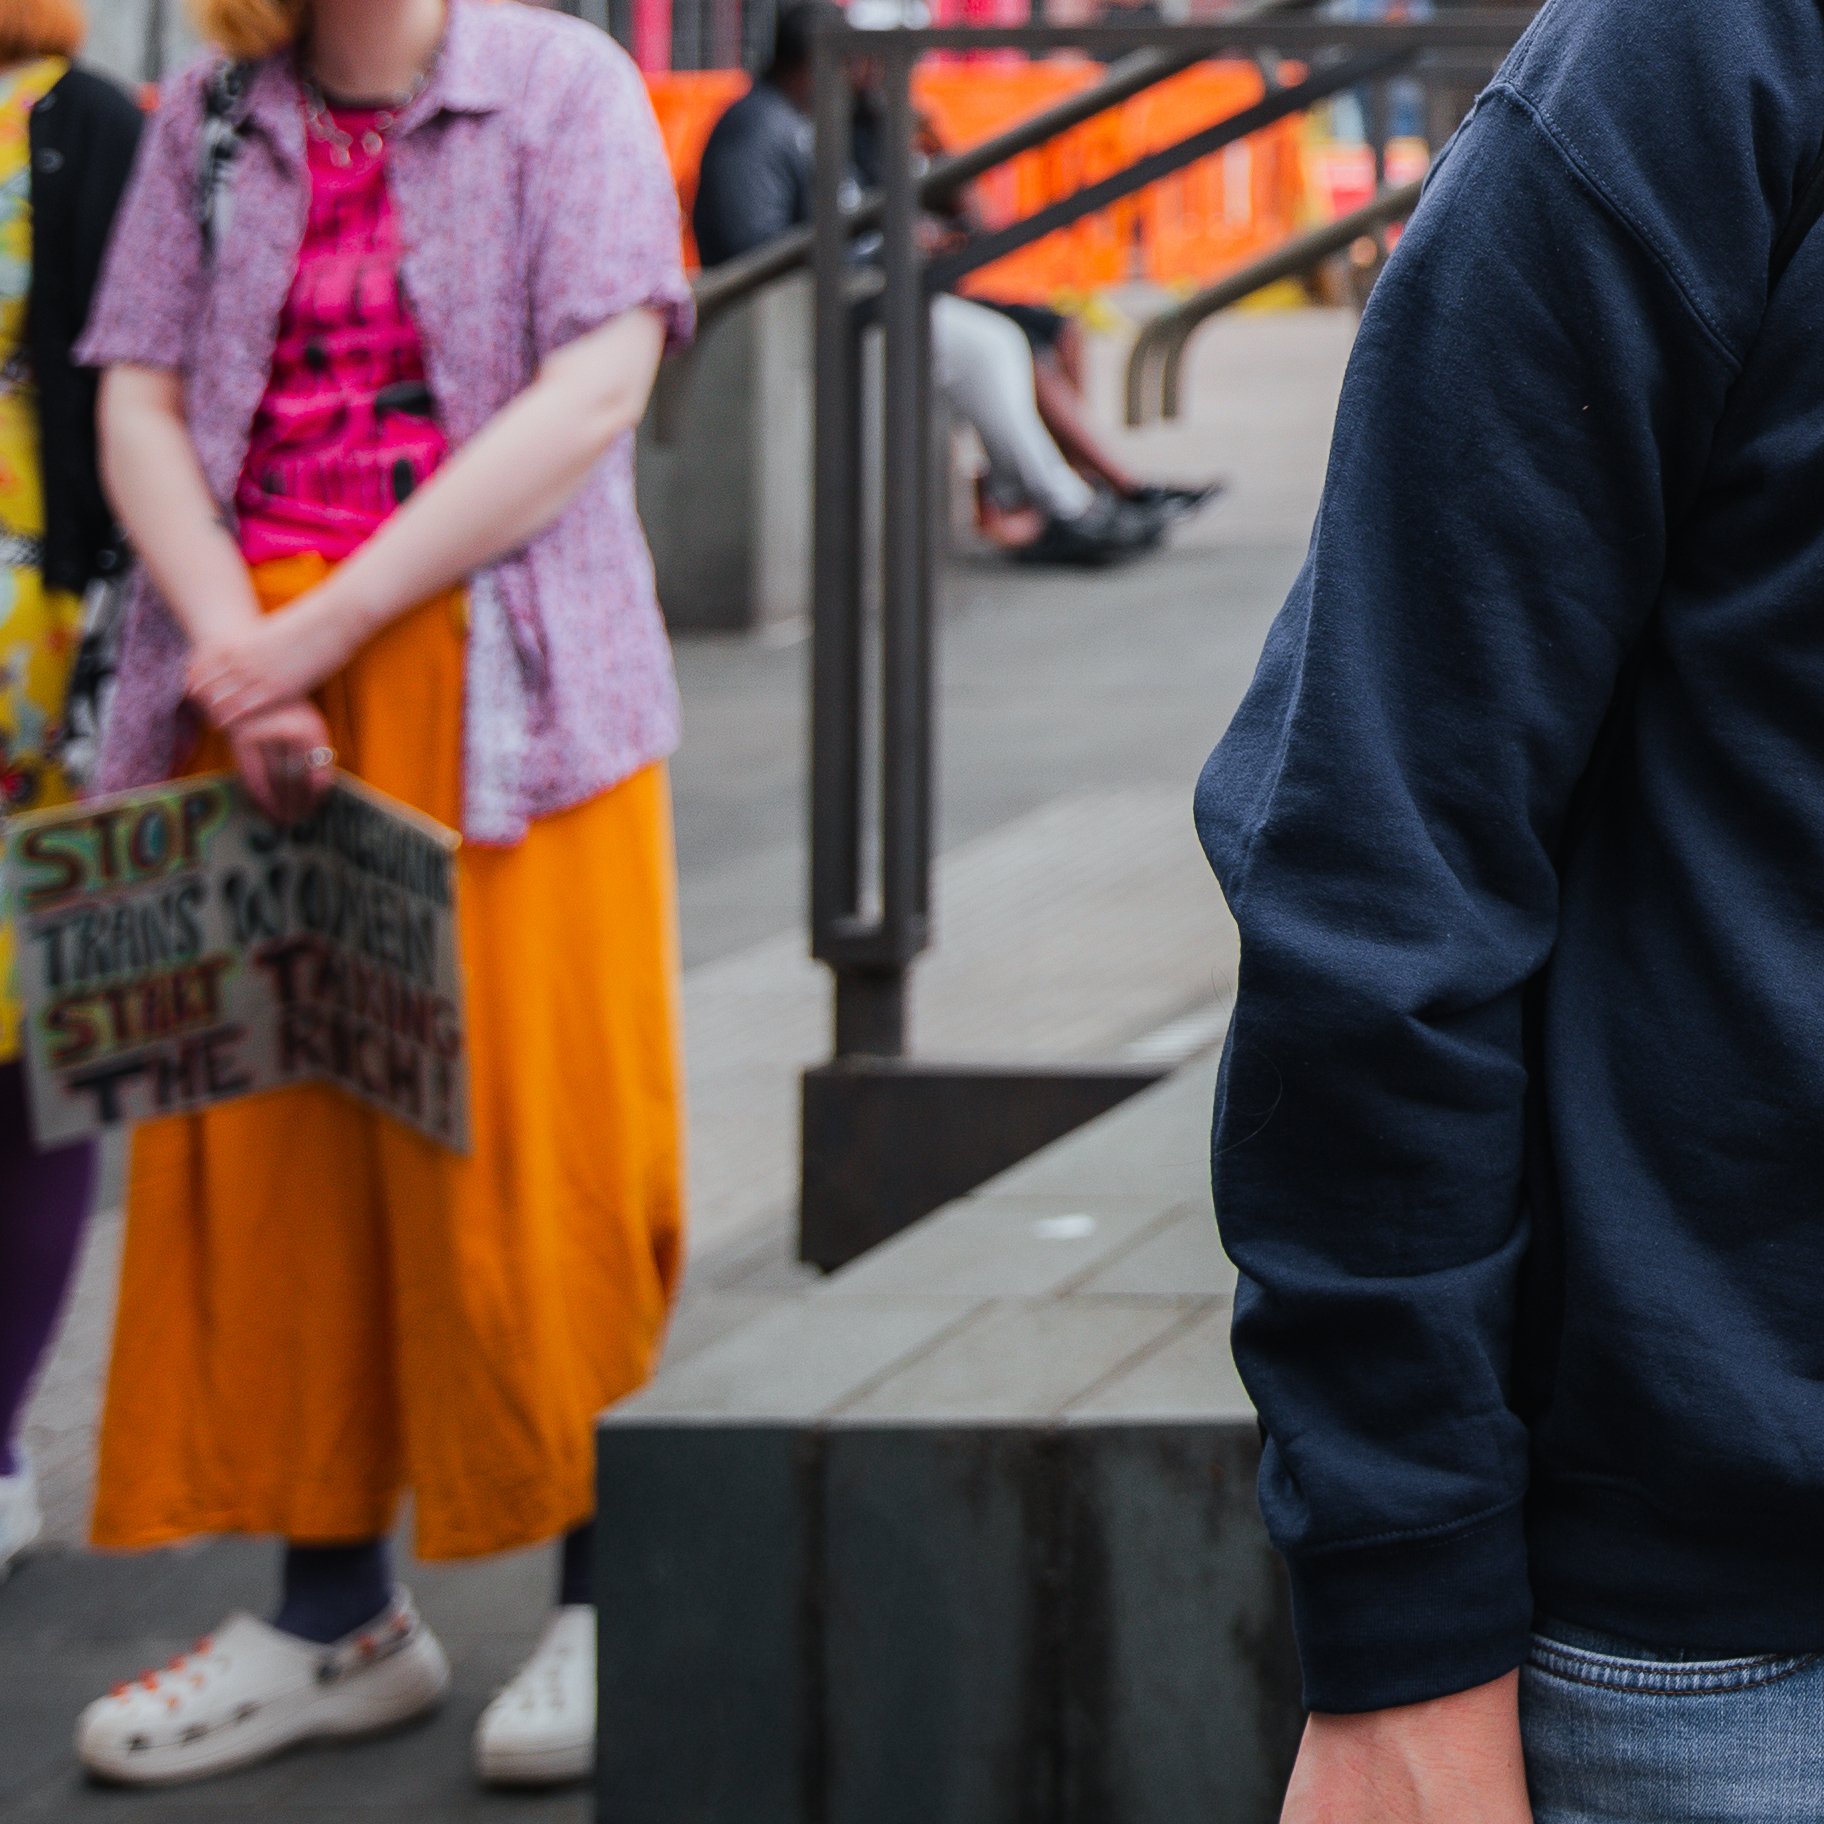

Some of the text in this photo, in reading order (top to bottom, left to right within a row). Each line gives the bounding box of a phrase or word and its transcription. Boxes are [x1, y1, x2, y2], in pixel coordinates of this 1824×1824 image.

[19, 786, 226, 909] STOP
[30, 882, 203, 988] TRANS
[65, 1022, 254, 1126] THE
